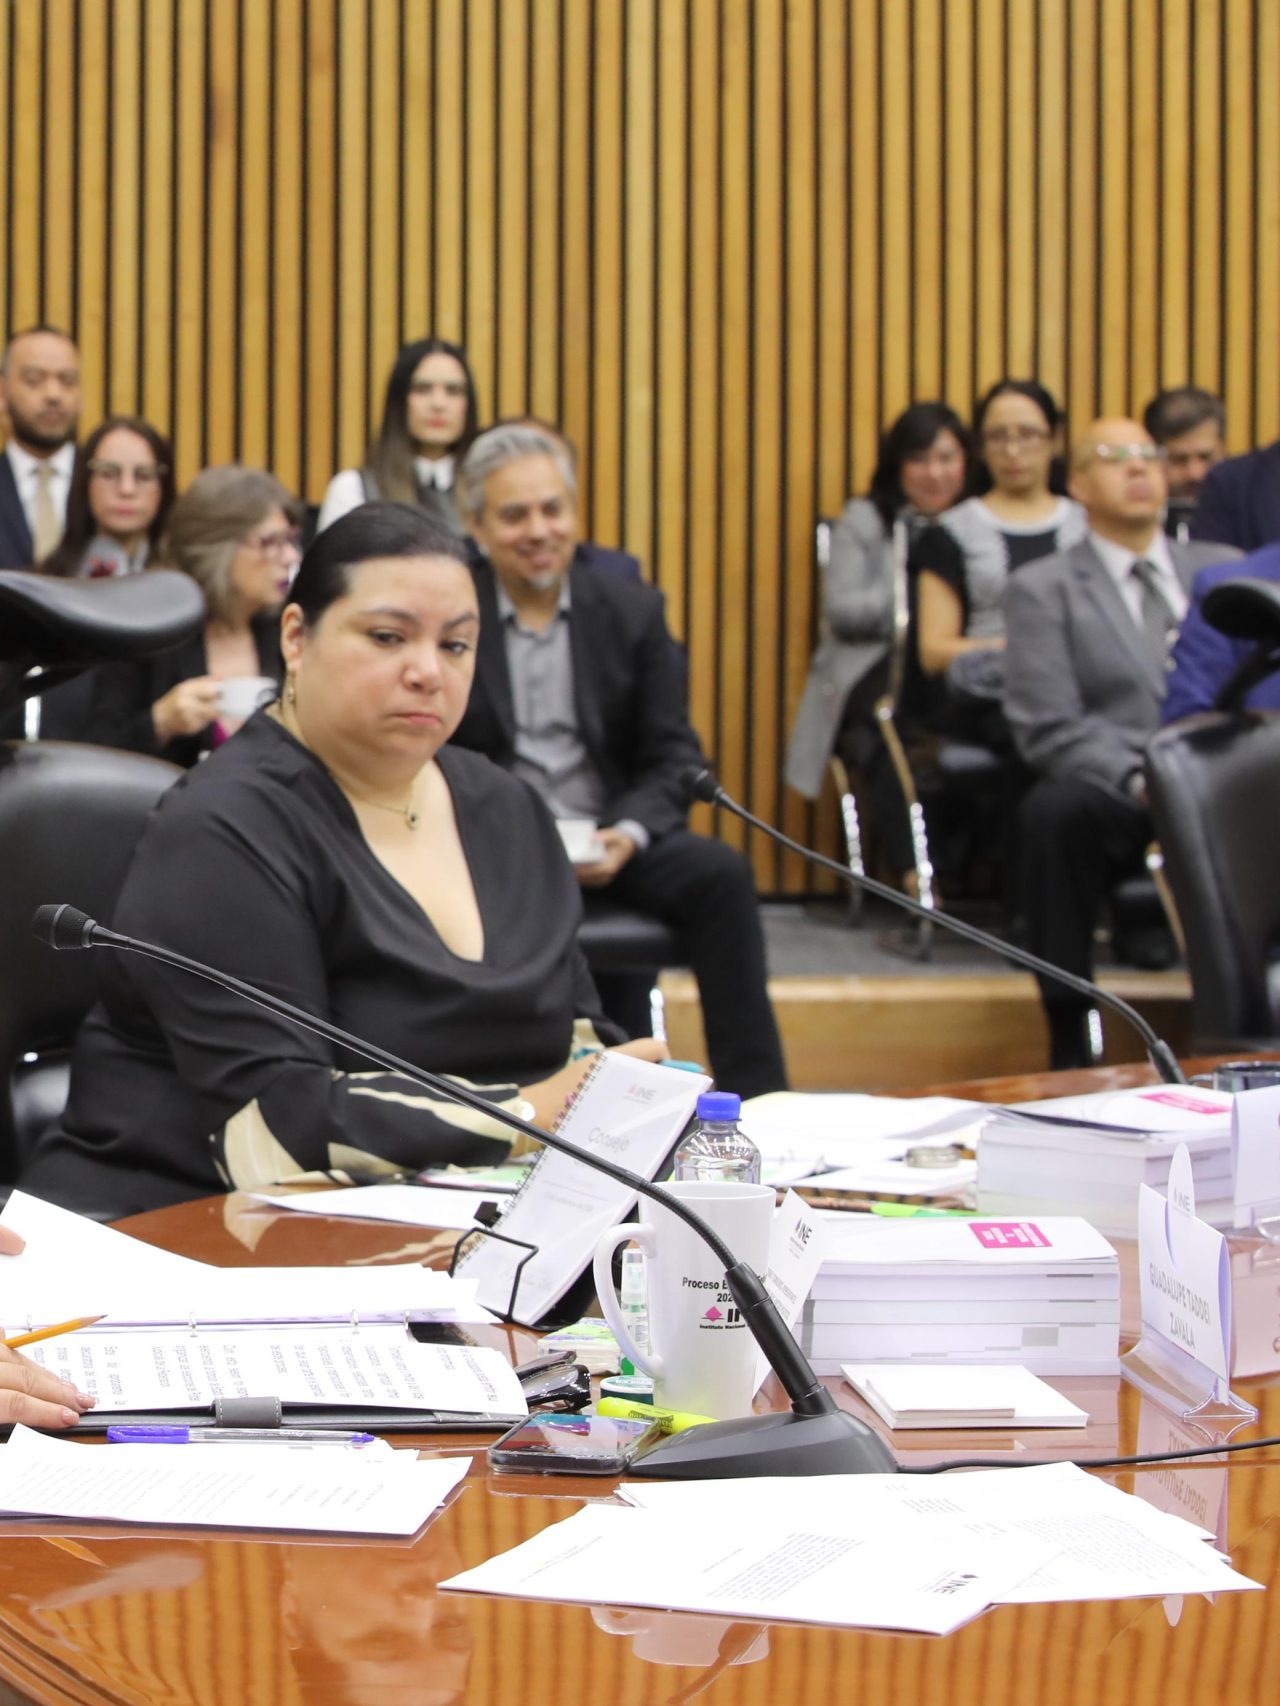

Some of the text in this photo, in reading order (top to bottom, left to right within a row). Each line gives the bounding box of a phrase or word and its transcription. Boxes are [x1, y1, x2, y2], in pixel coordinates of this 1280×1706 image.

[636, 1086, 657, 1101] INE
[588, 1126, 631, 1154] Consejo
[1177, 1191, 1191, 1212] INE
[798, 1222, 813, 1245] INE
[682, 1277, 720, 1290] Proceso
[1149, 1262, 1211, 1327] GUADALUPE TADDEI
[717, 1293, 735, 1303] 202
[1169, 1312, 1196, 1350] ZAVALA
